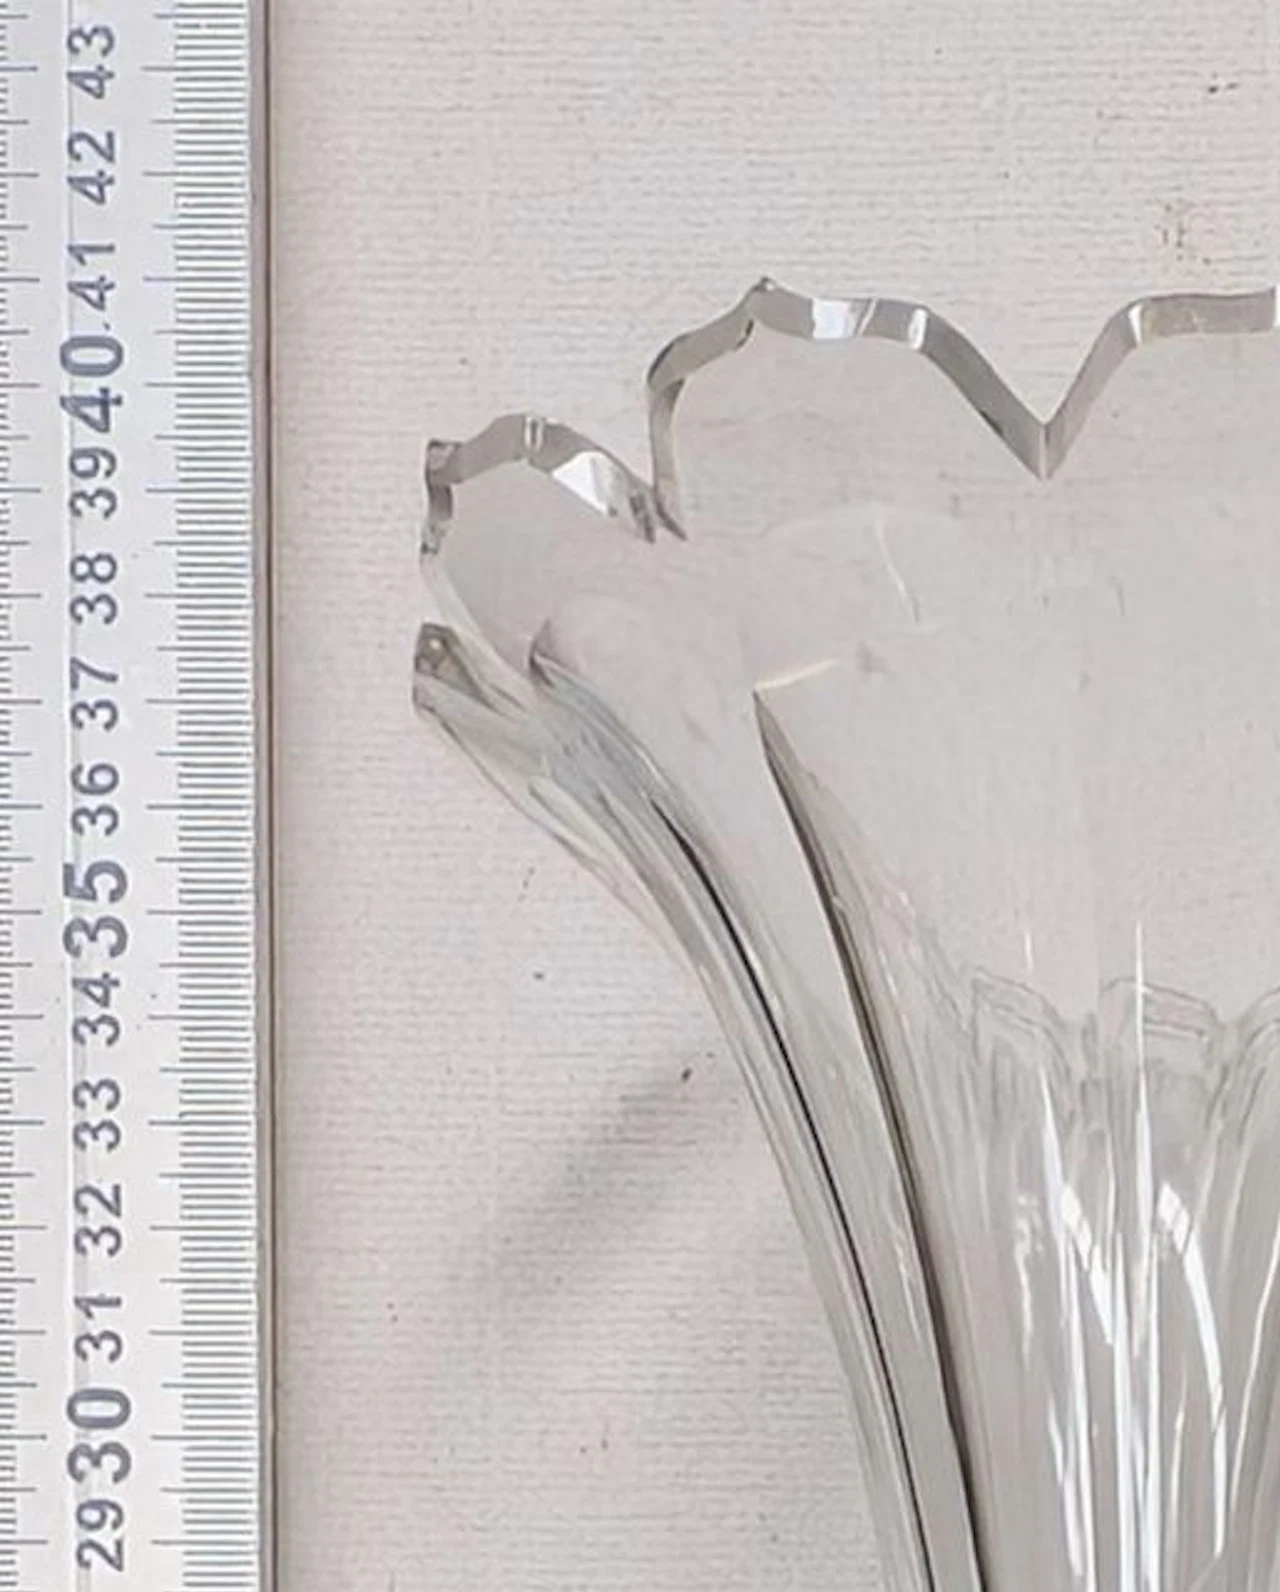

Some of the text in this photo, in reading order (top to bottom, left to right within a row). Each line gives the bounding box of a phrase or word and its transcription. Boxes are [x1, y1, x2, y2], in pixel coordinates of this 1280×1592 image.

[65, 24, 116, 100] 43
[65, 129, 117, 206] 42
[66, 242, 117, 313] 41
[58, 334, 125, 435] 40
[67, 447, 118, 521] 39
[67, 544, 119, 626] 38
[68, 655, 120, 733] 37
[68, 760, 121, 838] 36
[61, 859, 129, 961] 35
[70, 970, 122, 1048] 34
[71, 1077, 123, 1154] 33
[72, 1182, 123, 1259] 32
[72, 1292, 124, 1364] 31
[65, 1386, 133, 1486] 30
[74, 1497, 125, 1574] 29
